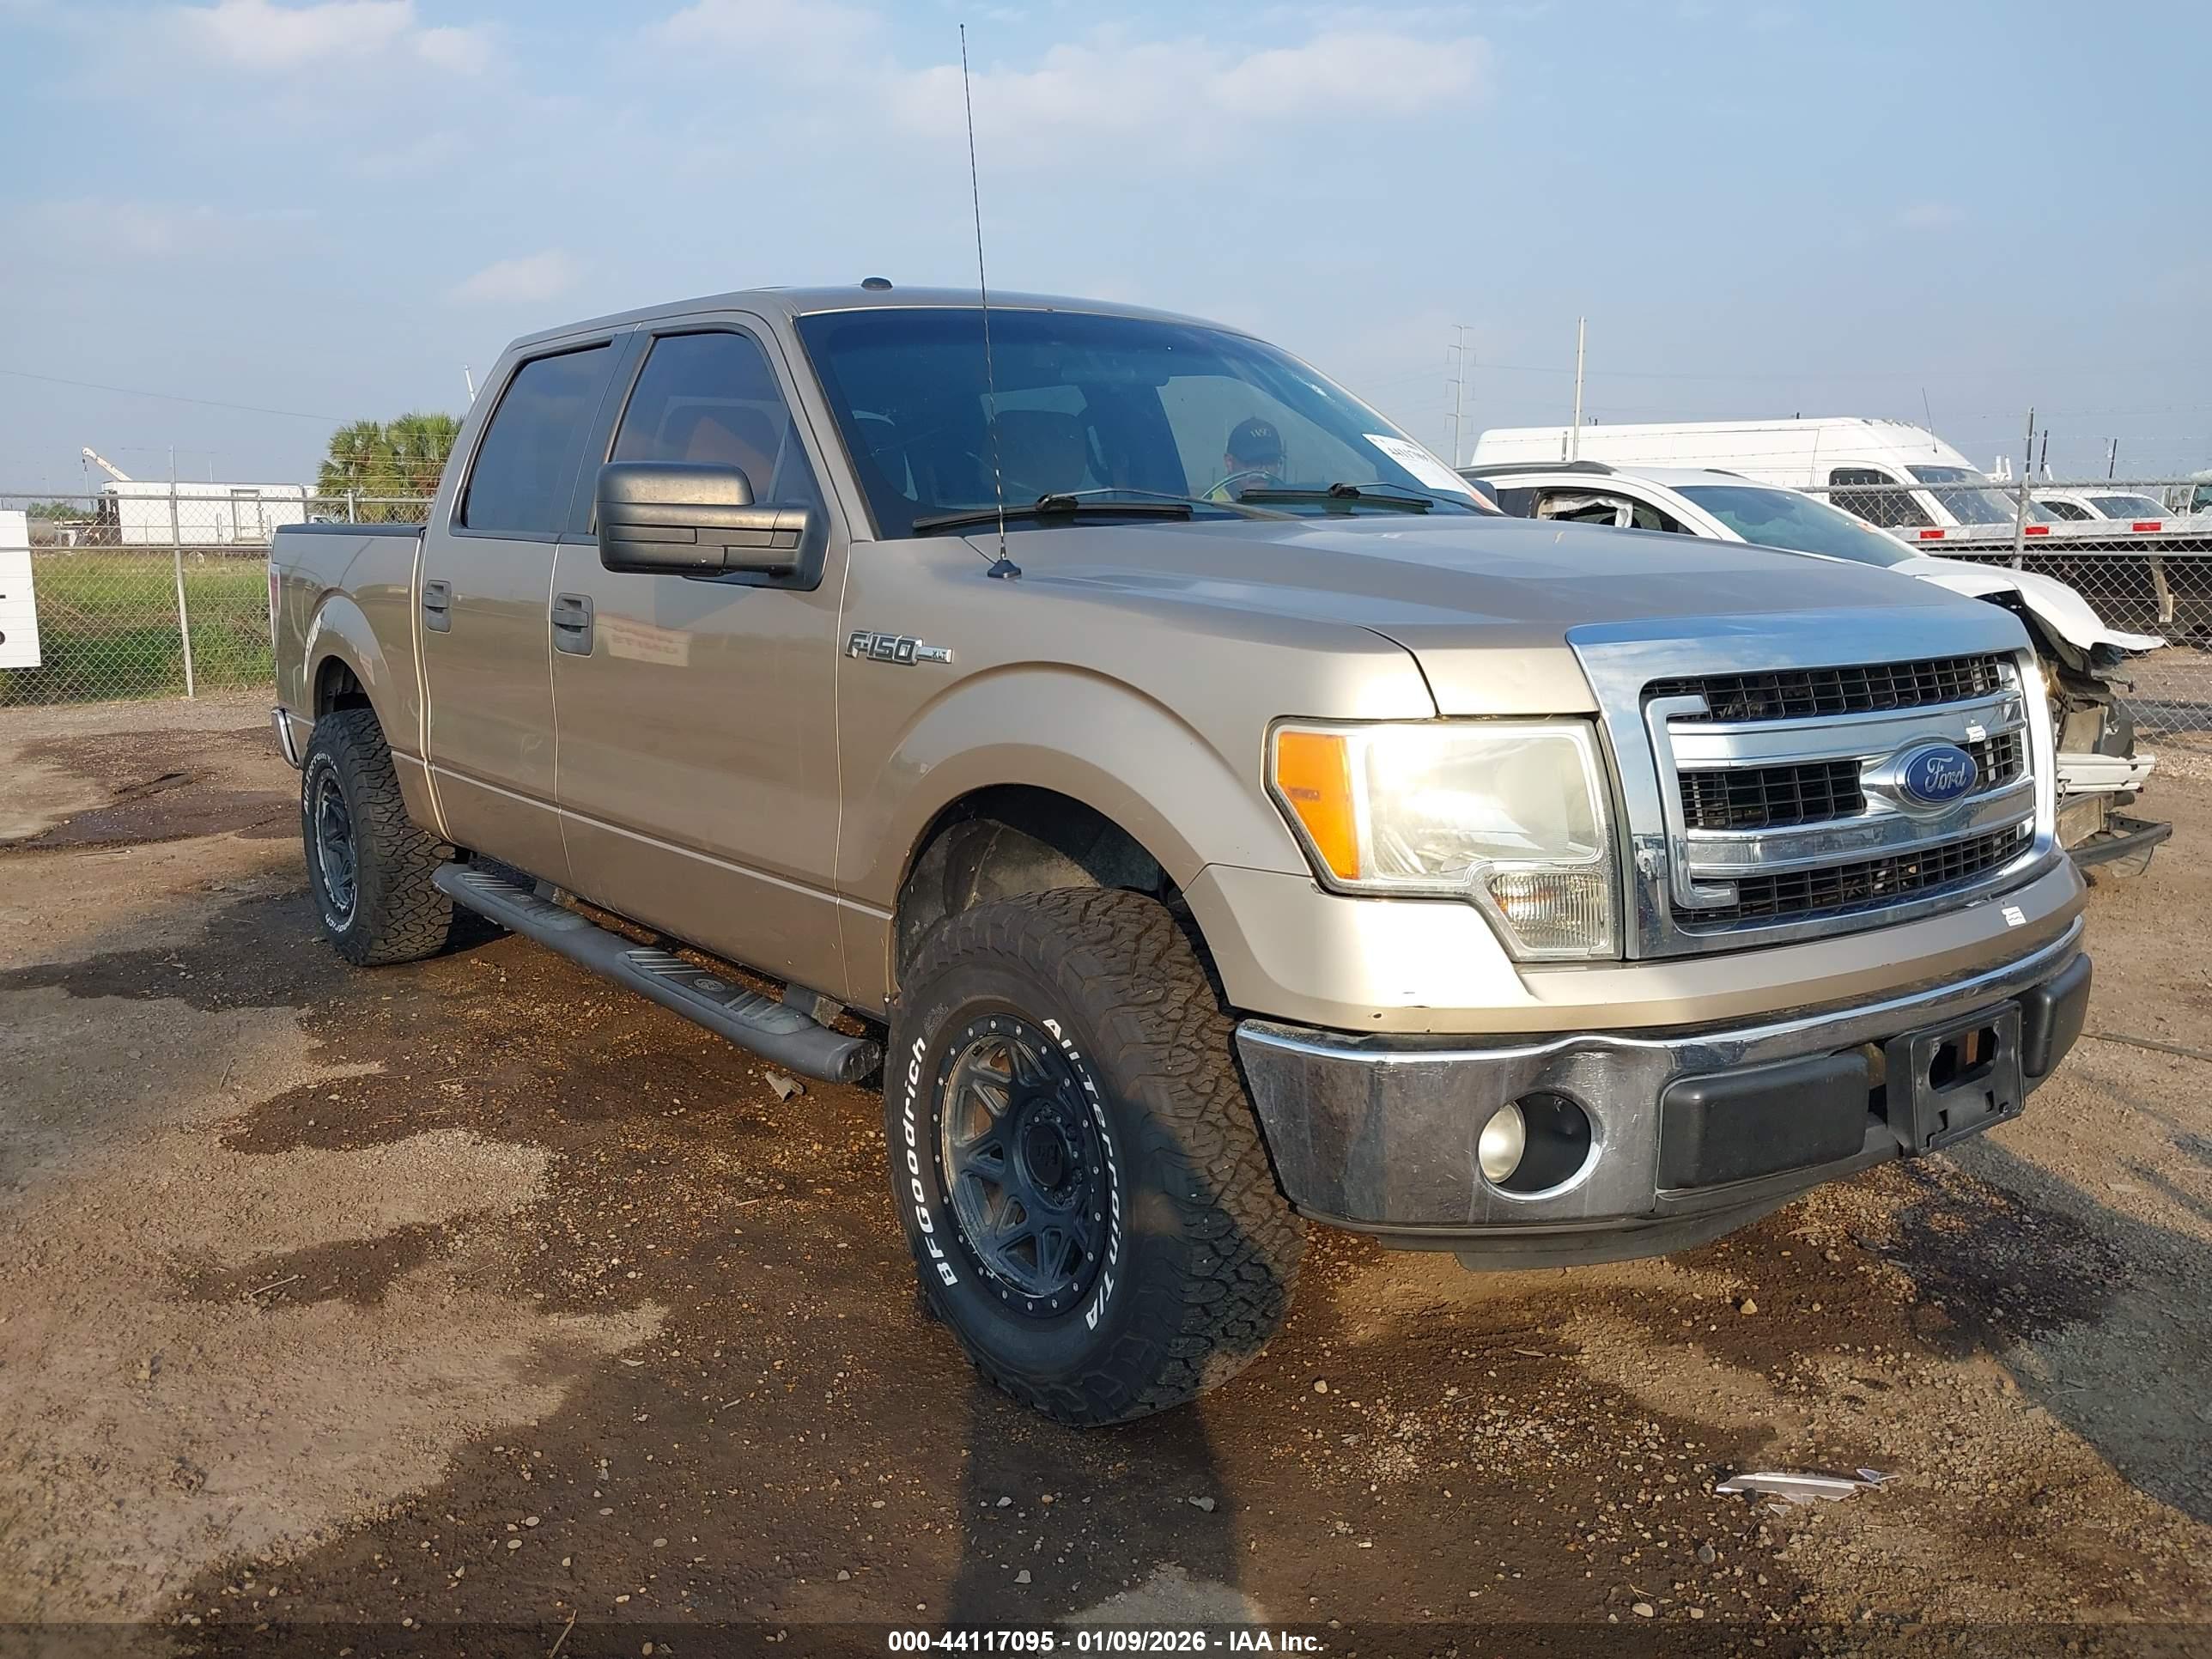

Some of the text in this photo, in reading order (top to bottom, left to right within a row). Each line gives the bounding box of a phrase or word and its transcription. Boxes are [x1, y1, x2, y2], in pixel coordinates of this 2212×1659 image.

[845, 631, 946, 666] F-150 XLT
[1924, 756, 1967, 793] Ford
[902, 1036, 959, 1287] BFGoodrich
[1042, 1018, 1124, 1331] All-Terrain T/A
